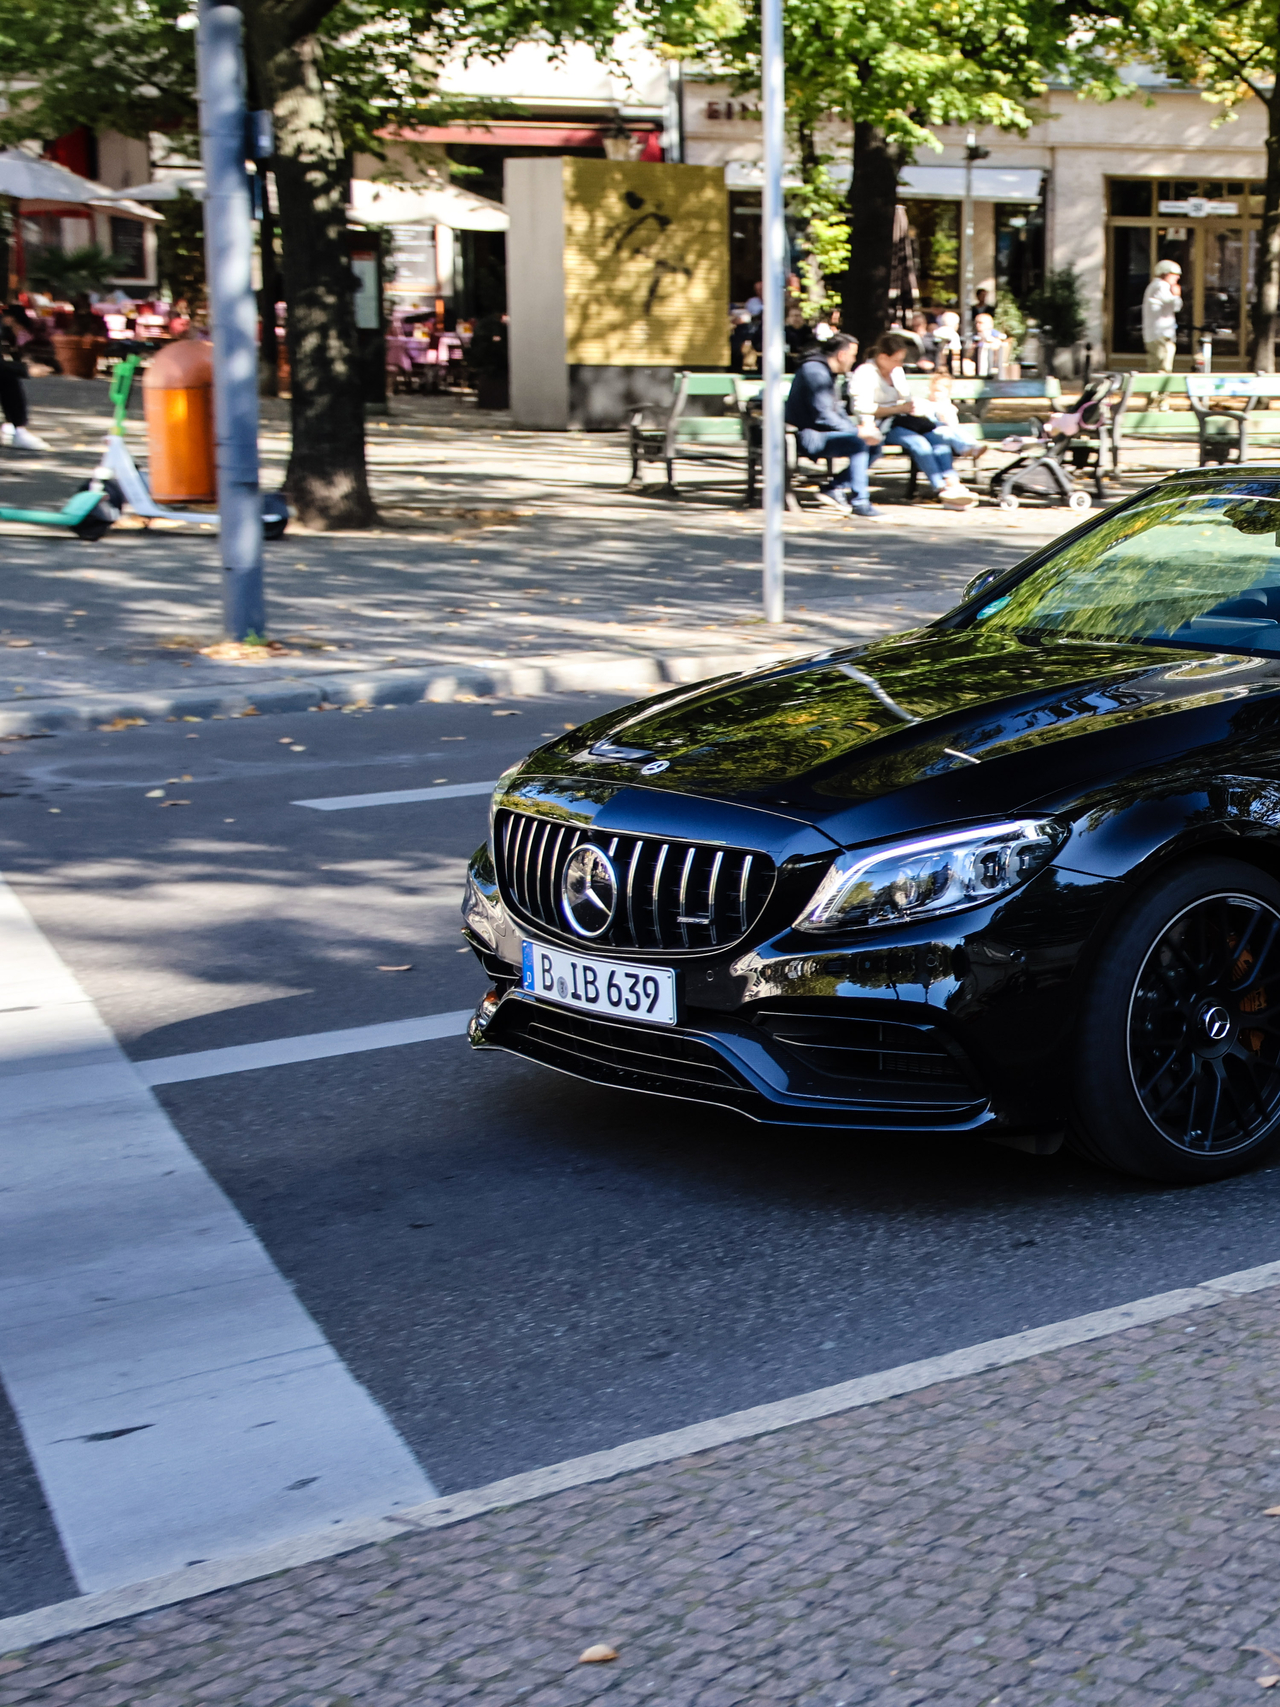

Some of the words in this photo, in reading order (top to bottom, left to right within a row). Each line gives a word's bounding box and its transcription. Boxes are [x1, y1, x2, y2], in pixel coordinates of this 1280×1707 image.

[526, 971, 532, 983] D
[541, 952, 555, 992] B
[571, 961, 600, 1004] IB
[607, 969, 660, 1014] 639
